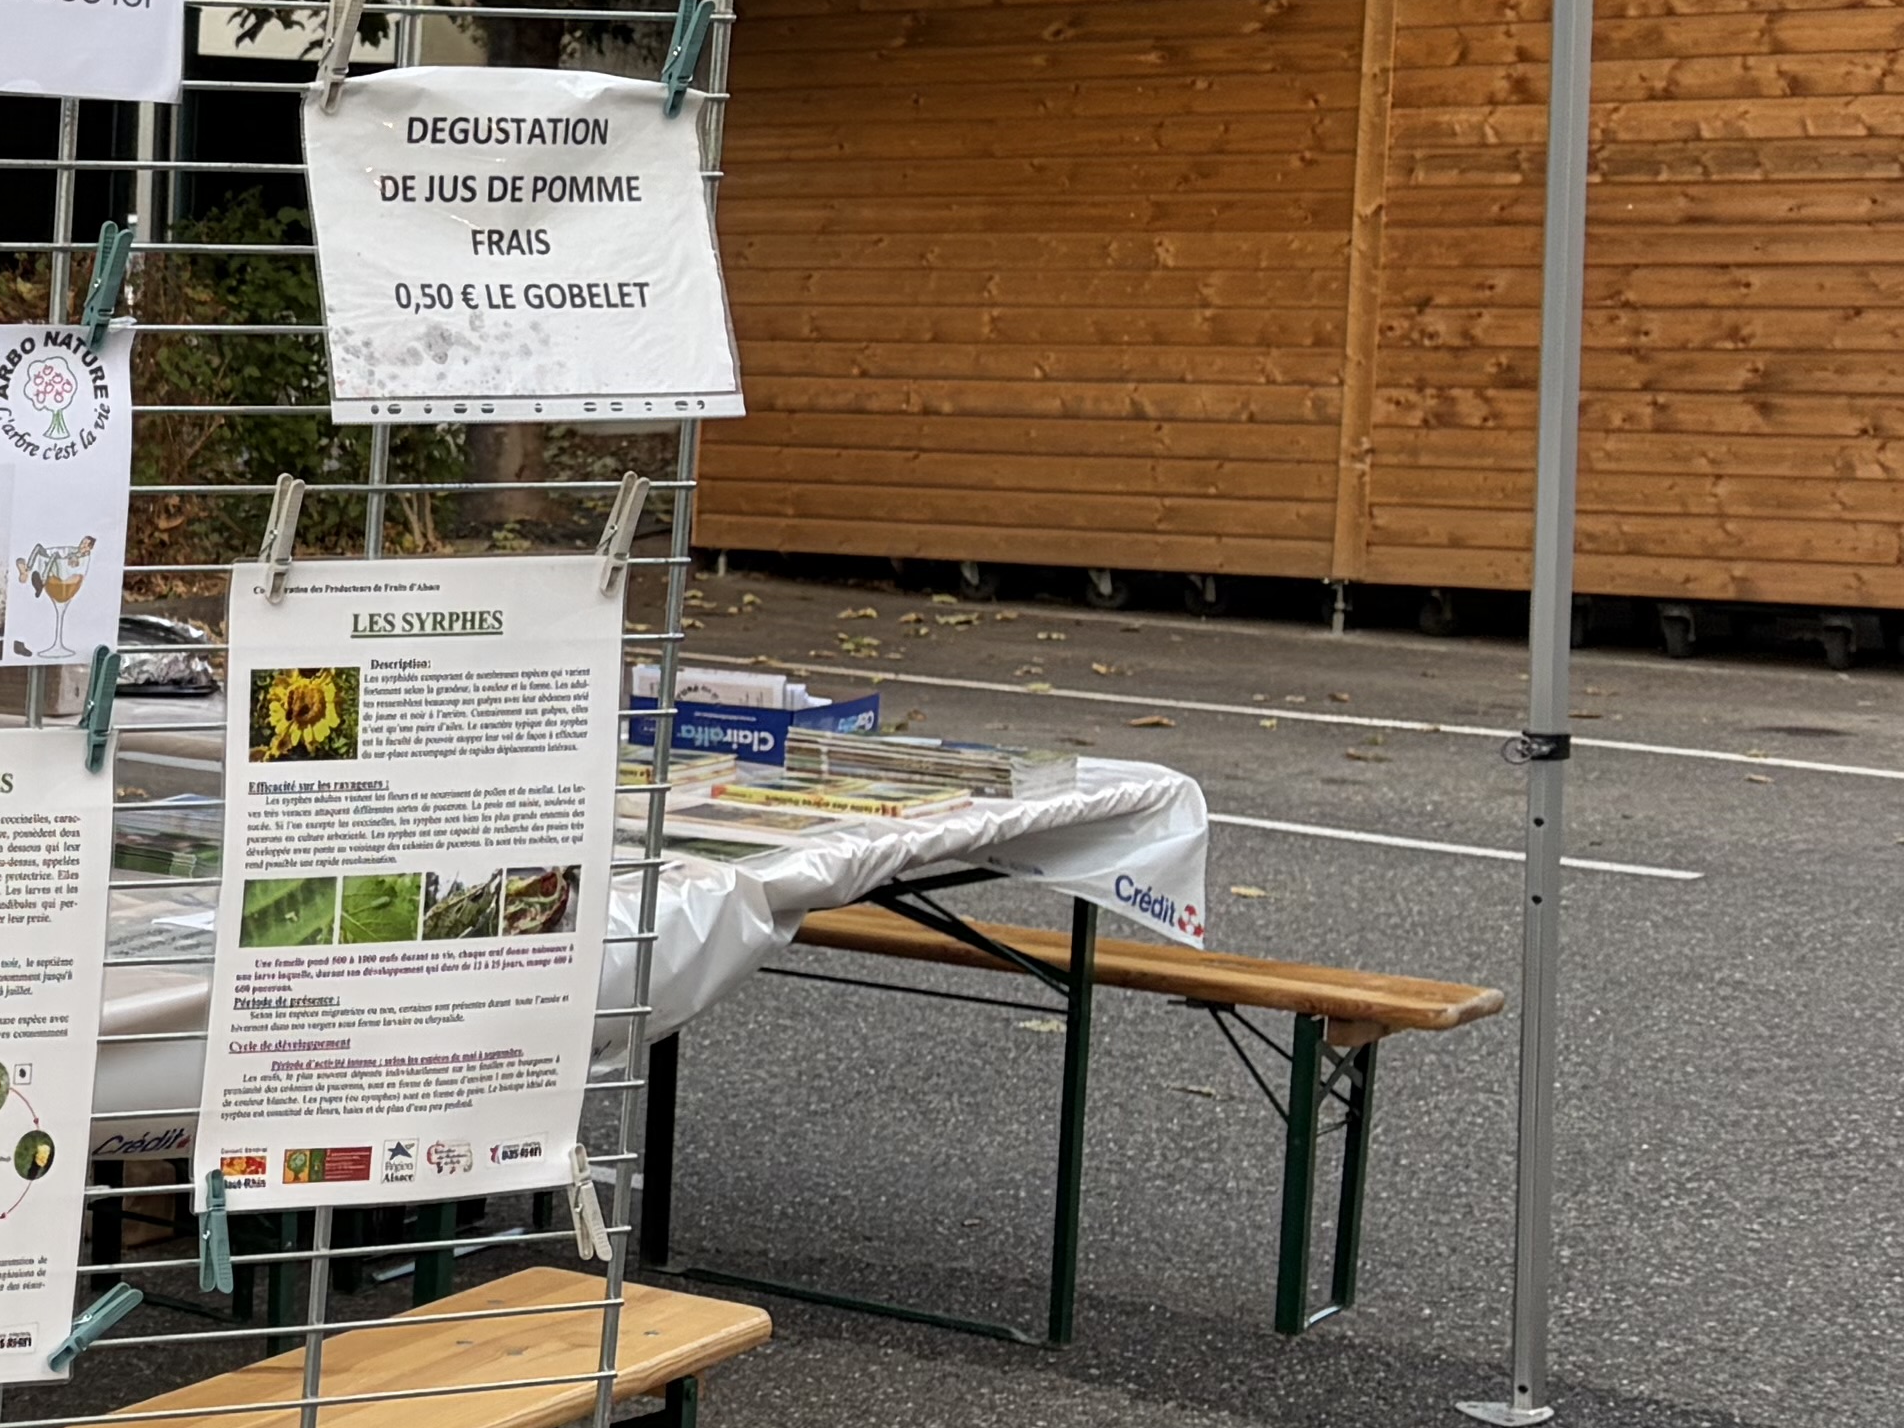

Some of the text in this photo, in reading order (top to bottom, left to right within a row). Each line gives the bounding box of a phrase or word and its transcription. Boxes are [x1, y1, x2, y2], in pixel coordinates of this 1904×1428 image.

[407, 116, 609, 146] DEGUSTATION
[380, 174, 642, 203] DE JUS DE POMME
[471, 228, 551, 256] FRAIS
[395, 282, 650, 315] 0,50 € LE GOBELET
[352, 610, 503, 633] LES SYRPHES
[680, 724, 774, 752] Clairalfa
[1113, 873, 1177, 930] Crédit
